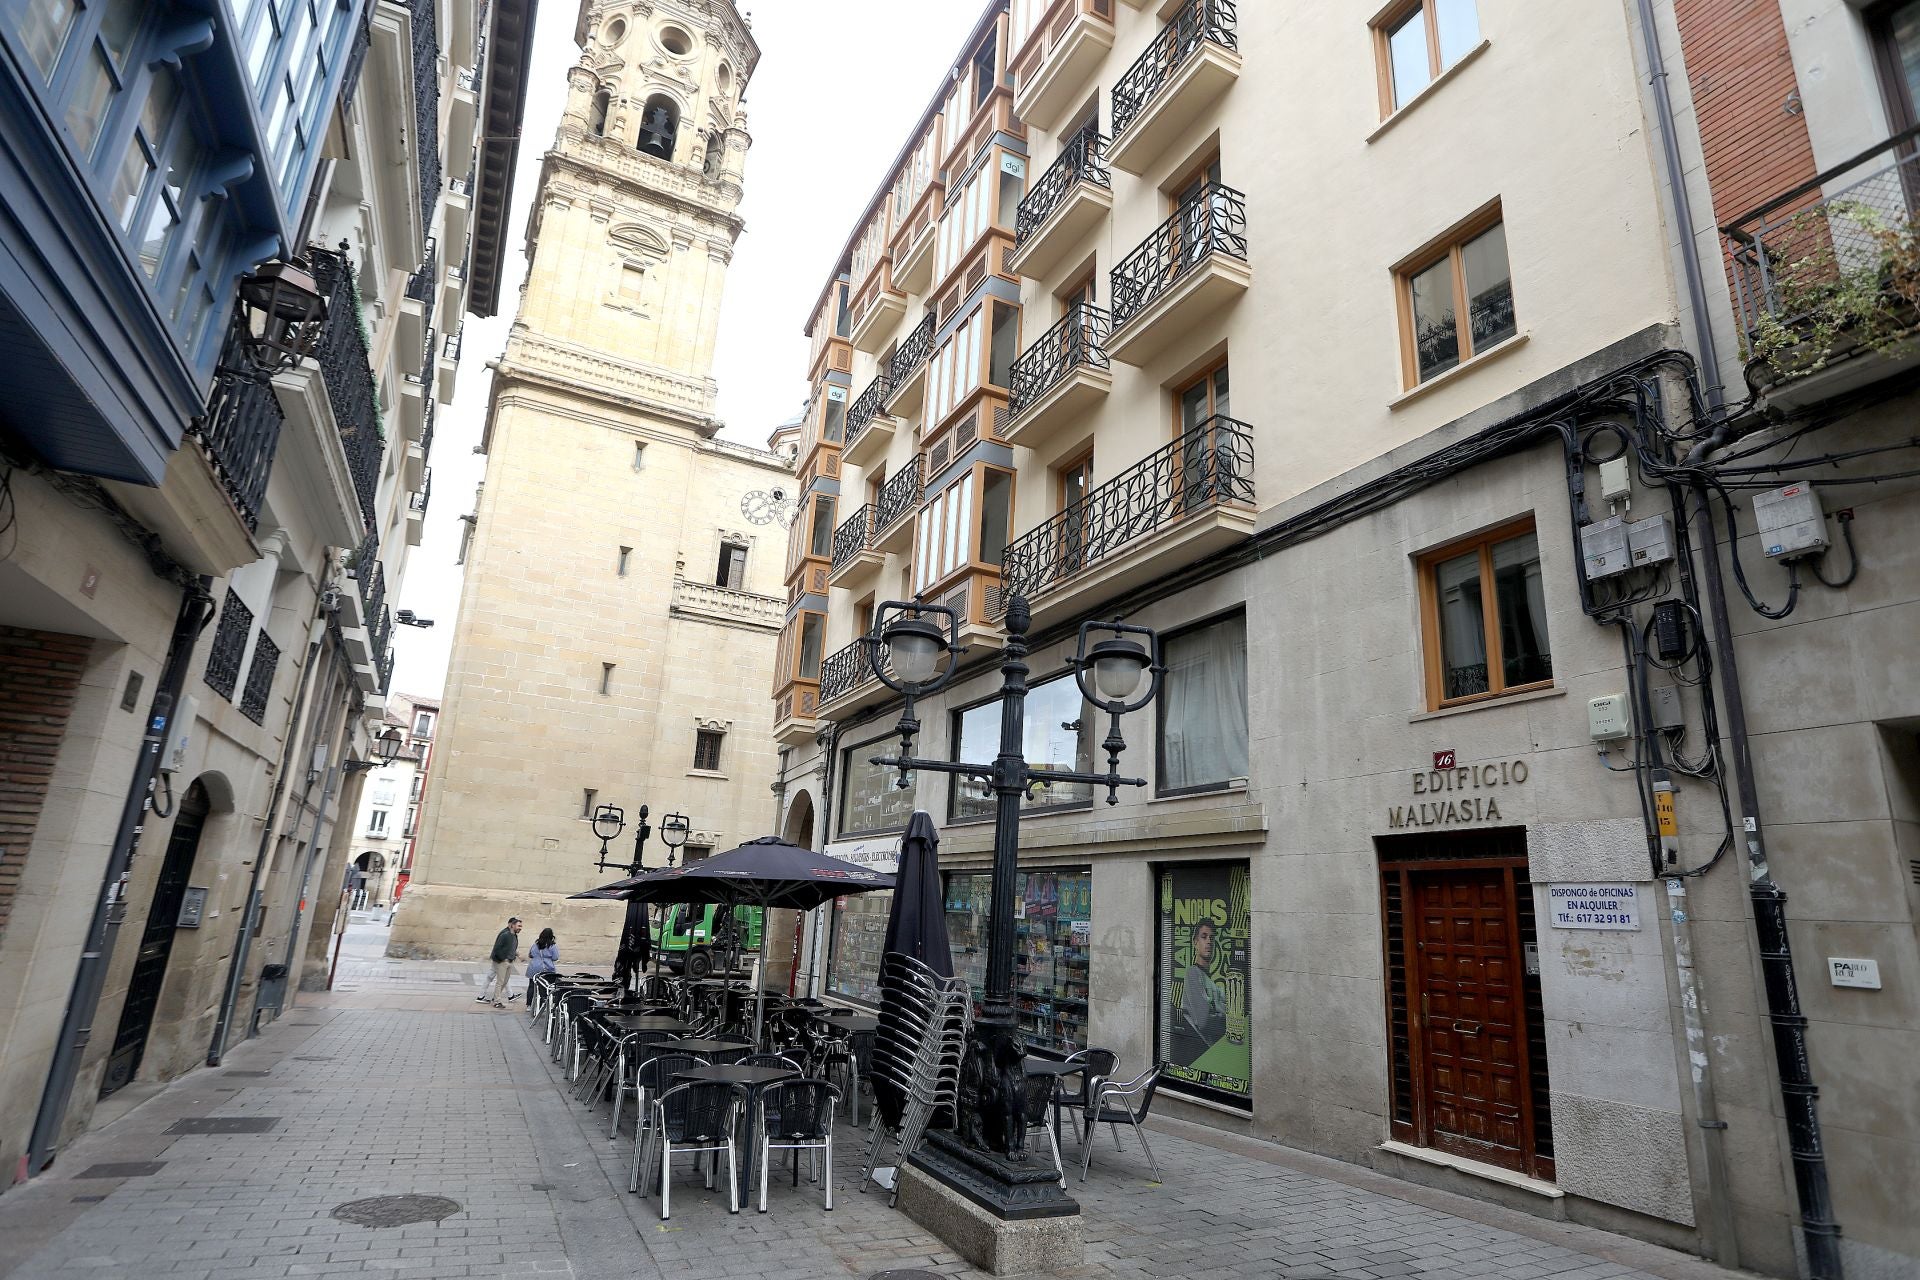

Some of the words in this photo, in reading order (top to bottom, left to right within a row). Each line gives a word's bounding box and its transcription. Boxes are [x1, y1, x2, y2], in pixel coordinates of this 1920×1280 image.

[1437, 754, 1453, 766] 16
[1412, 760, 1529, 795] EDIFICIO
[1388, 797, 1502, 828] MALVASIA
[1551, 888, 1588, 898] DISPONGO
[1588, 888, 1598, 898] de
[1599, 888, 1634, 898] OFICINAS
[1567, 900, 1578, 910] EN
[1579, 901, 1619, 911] ALQUILER
[1576, 914, 1592, 923] 617
[1594, 914, 1605, 923] 32
[1606, 914, 1618, 924] 91
[1620, 914, 1631, 924] 81
